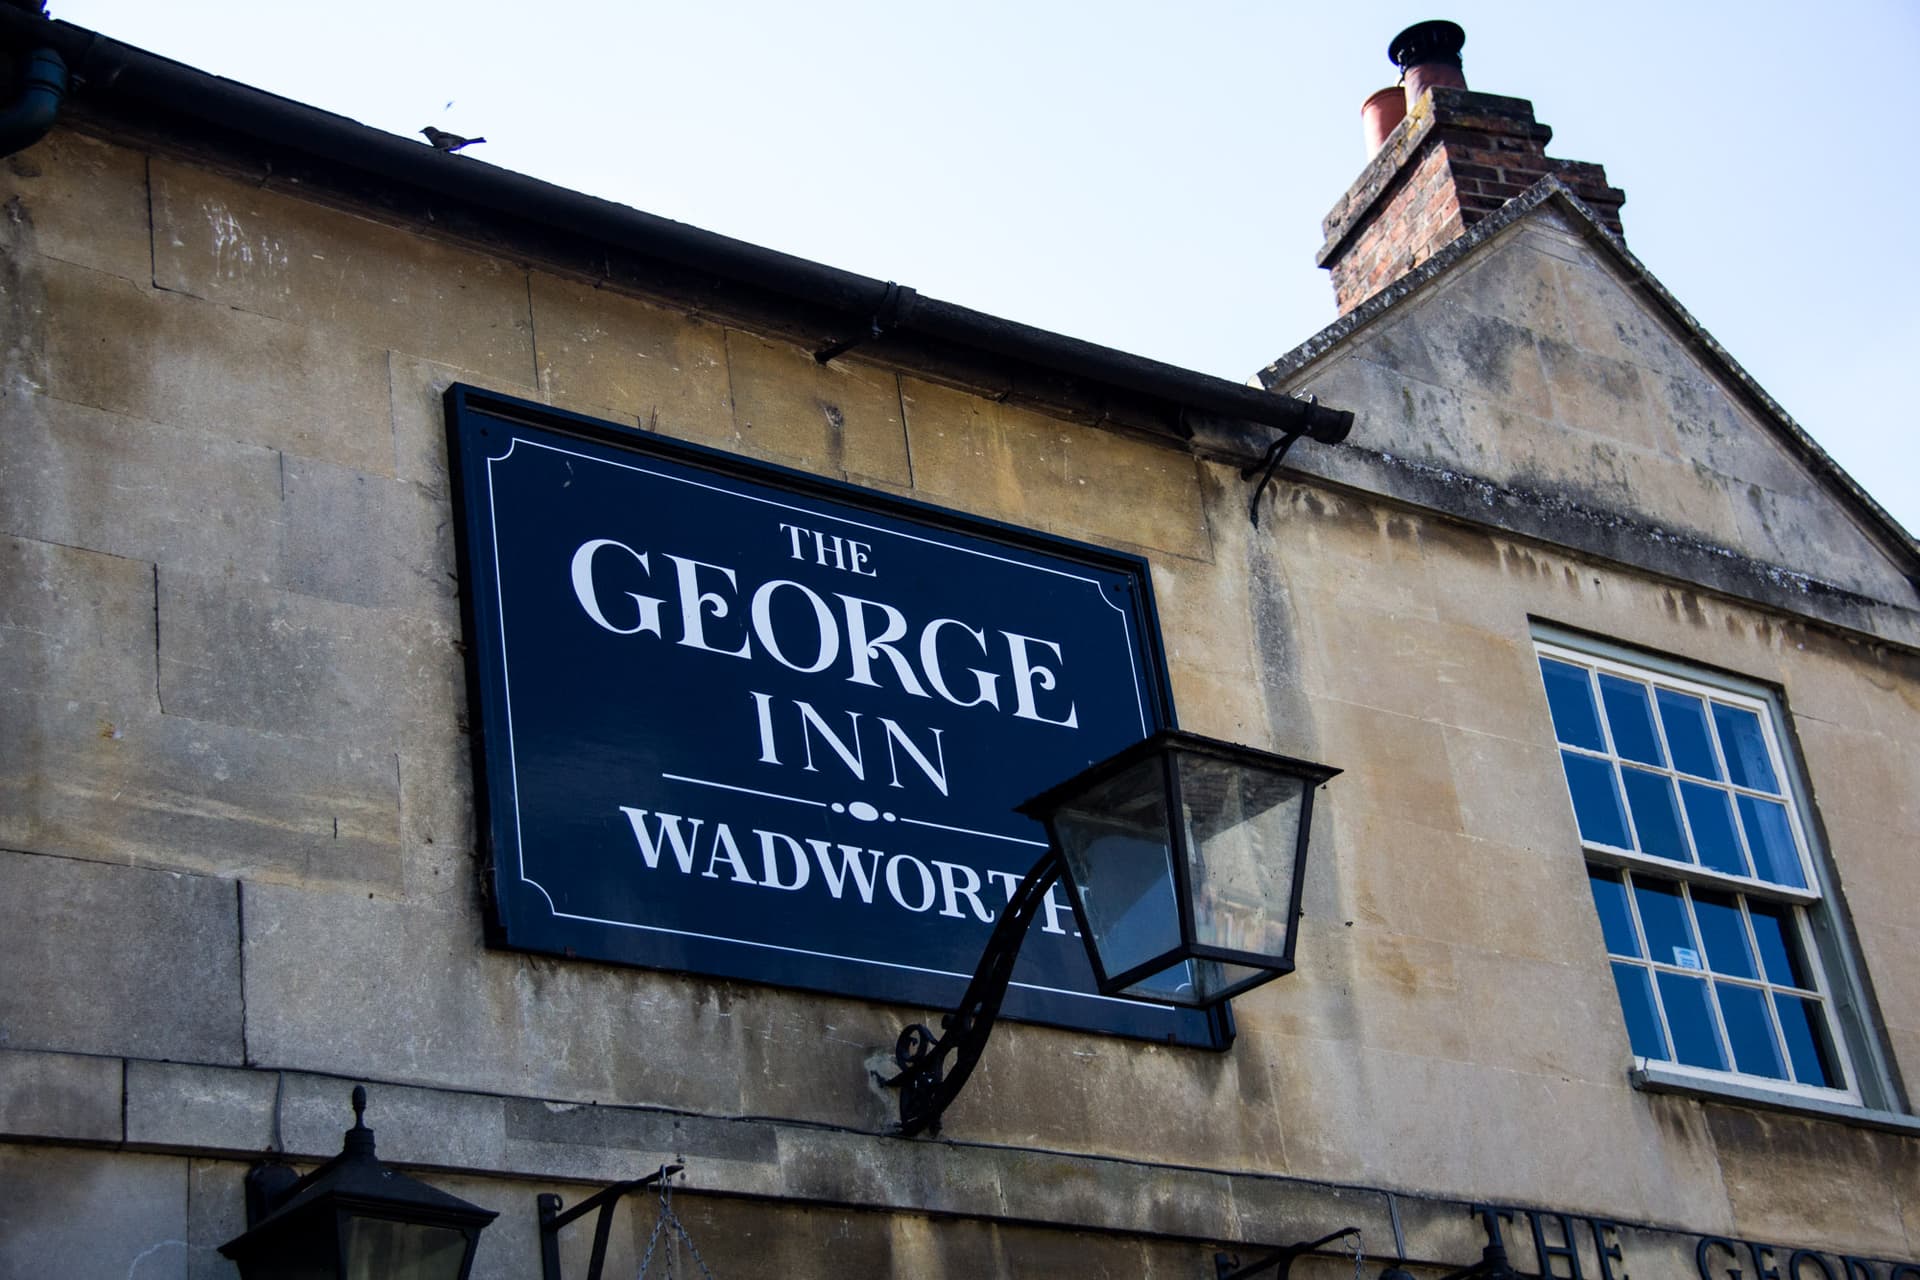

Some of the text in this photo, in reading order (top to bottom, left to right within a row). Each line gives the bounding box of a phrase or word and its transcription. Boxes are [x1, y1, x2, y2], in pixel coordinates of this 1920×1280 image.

[779, 523, 877, 577] THE
[571, 538, 1079, 729] GEORGE
[750, 690, 949, 797] INN
[1471, 1203, 1629, 1280] THE
